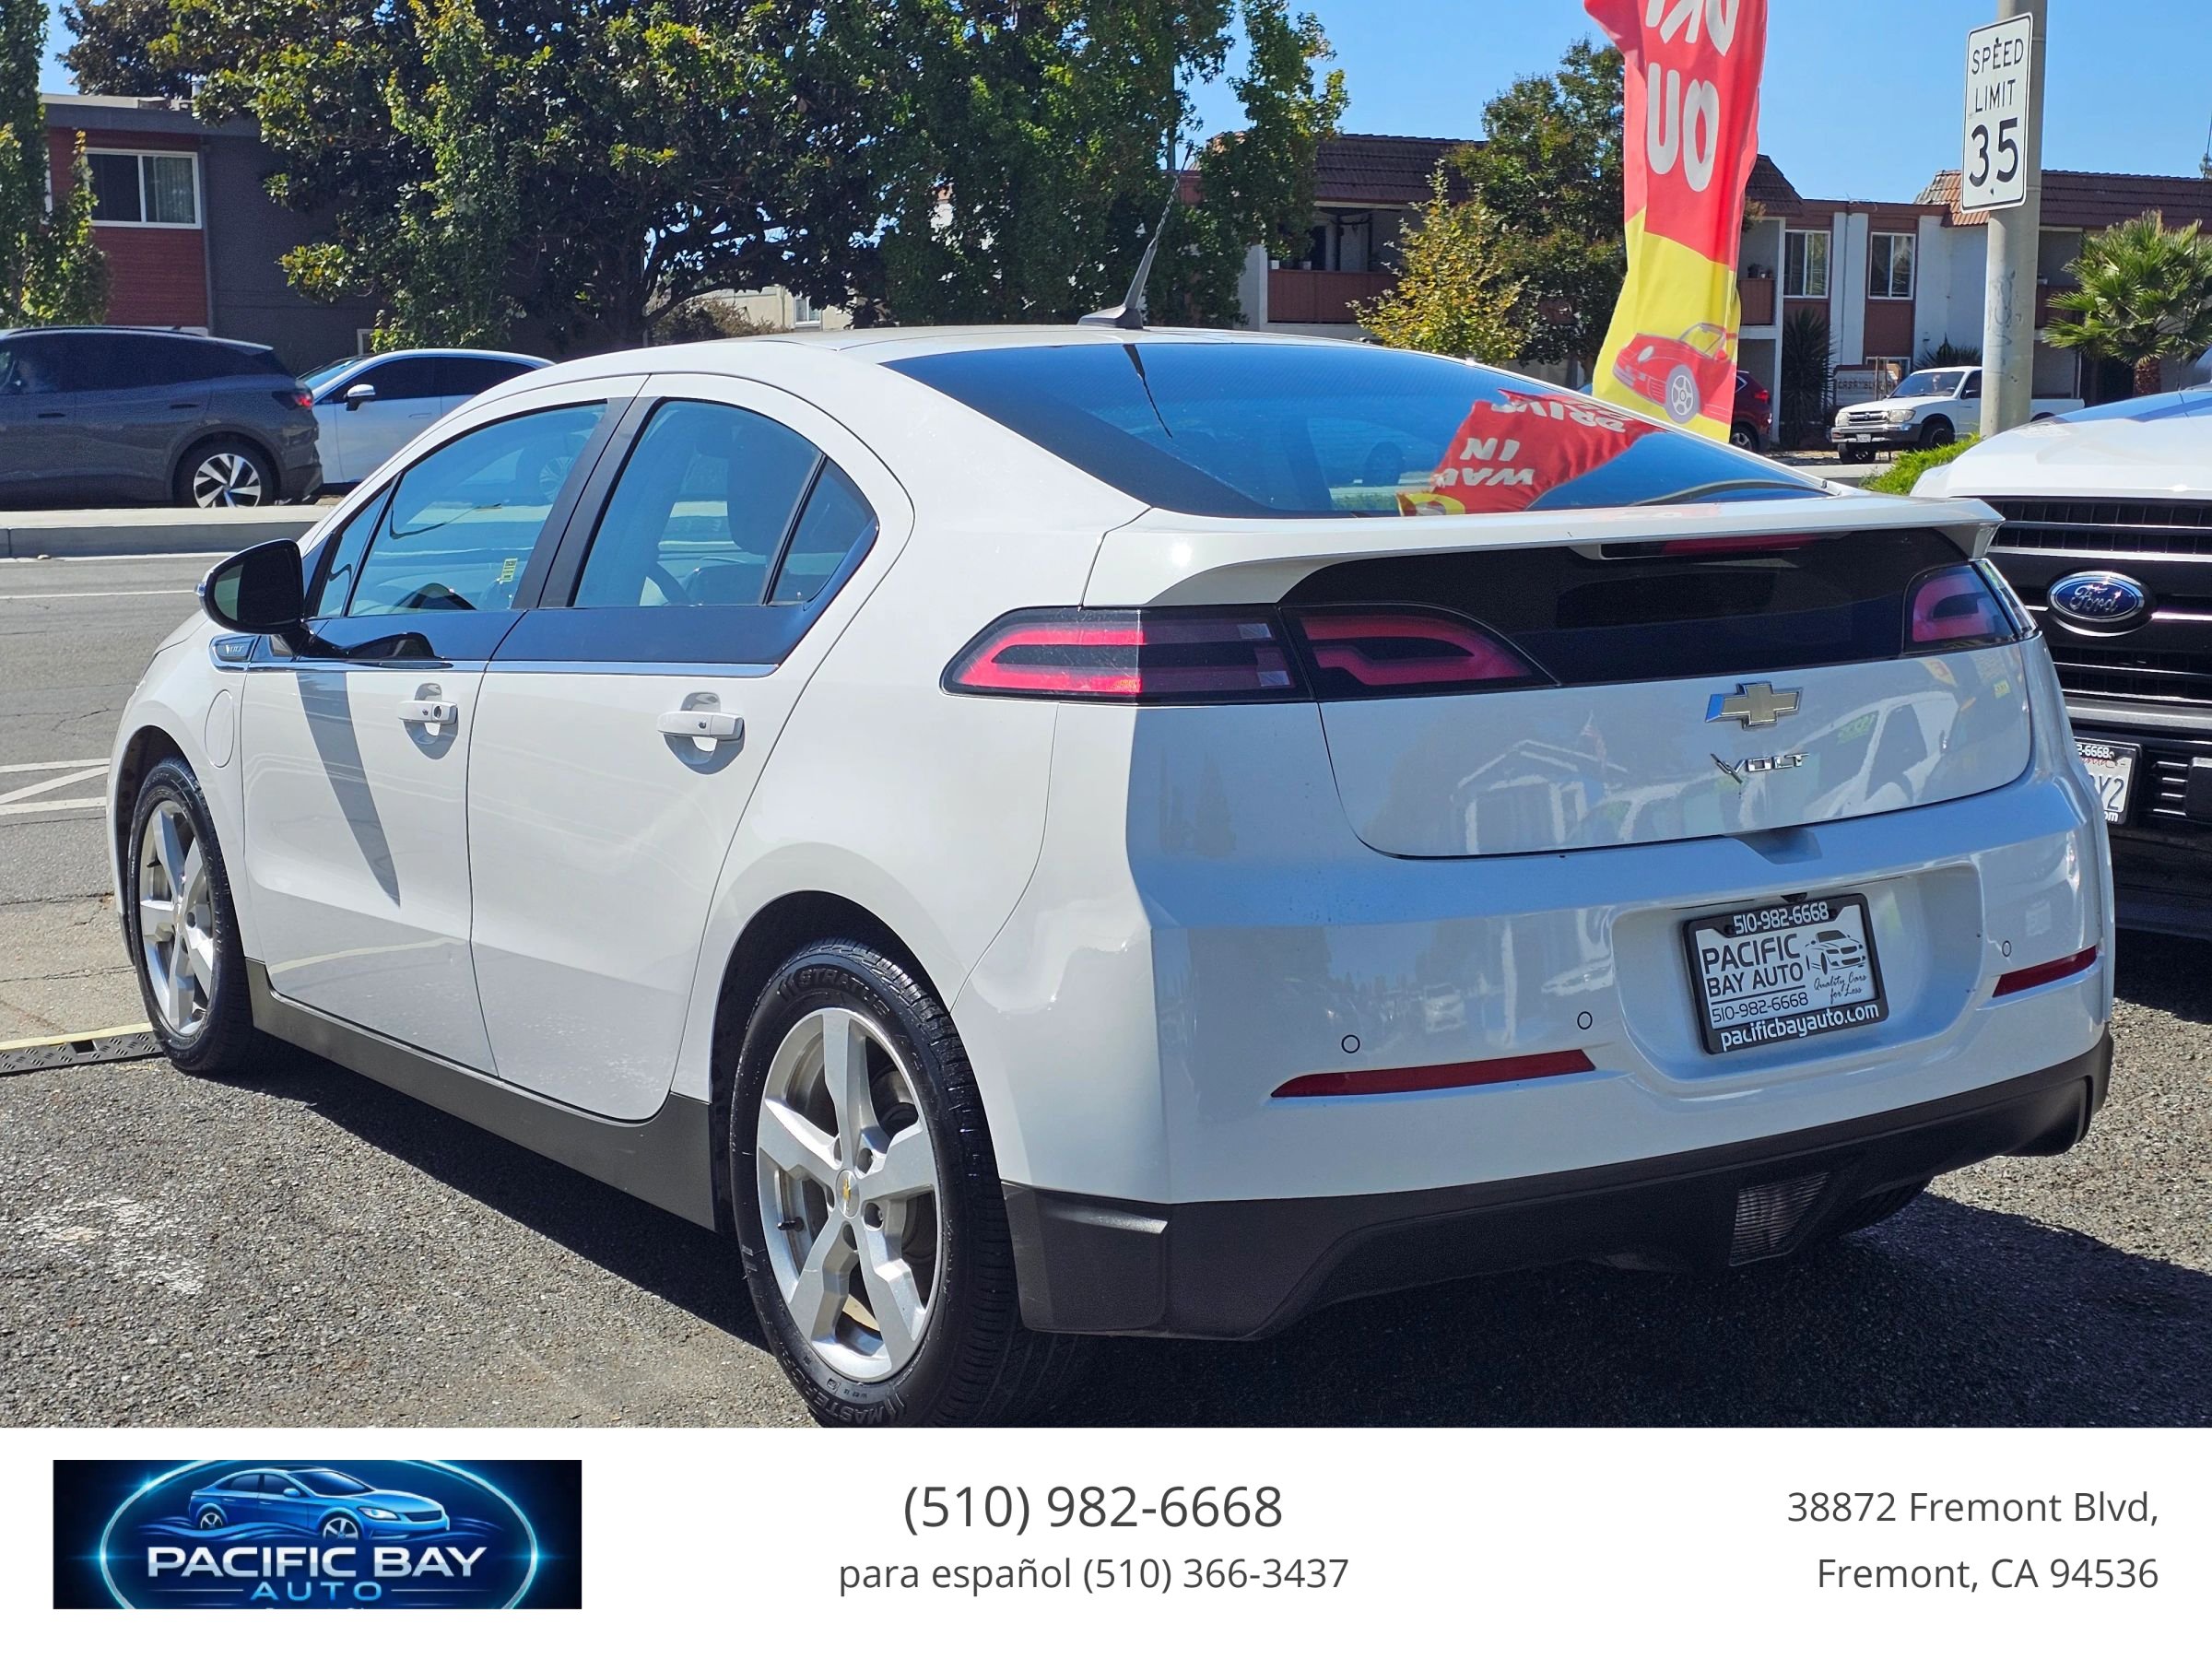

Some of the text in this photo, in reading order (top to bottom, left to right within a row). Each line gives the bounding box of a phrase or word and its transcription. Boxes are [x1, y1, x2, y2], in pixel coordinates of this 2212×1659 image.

[1971, 38, 2024, 75] SPEED
[1975, 79, 2016, 112] LIMIT
[1969, 117, 2018, 187] 35
[2069, 583, 2120, 613] Ford
[2076, 743, 2111, 759] 2-6668
[1711, 752, 1809, 784] VOLT
[1733, 901, 1830, 935] 510-982-6668
[1701, 933, 1801, 975] PACIFIC
[1706, 962, 1804, 998] BAY AUTO
[1814, 971, 1867, 992] Quality Cars
[1830, 983, 1863, 1005] for Less
[1712, 991, 1809, 1024] 510-982-6668
[1720, 1003, 1879, 1053] pacificbayauto.com
